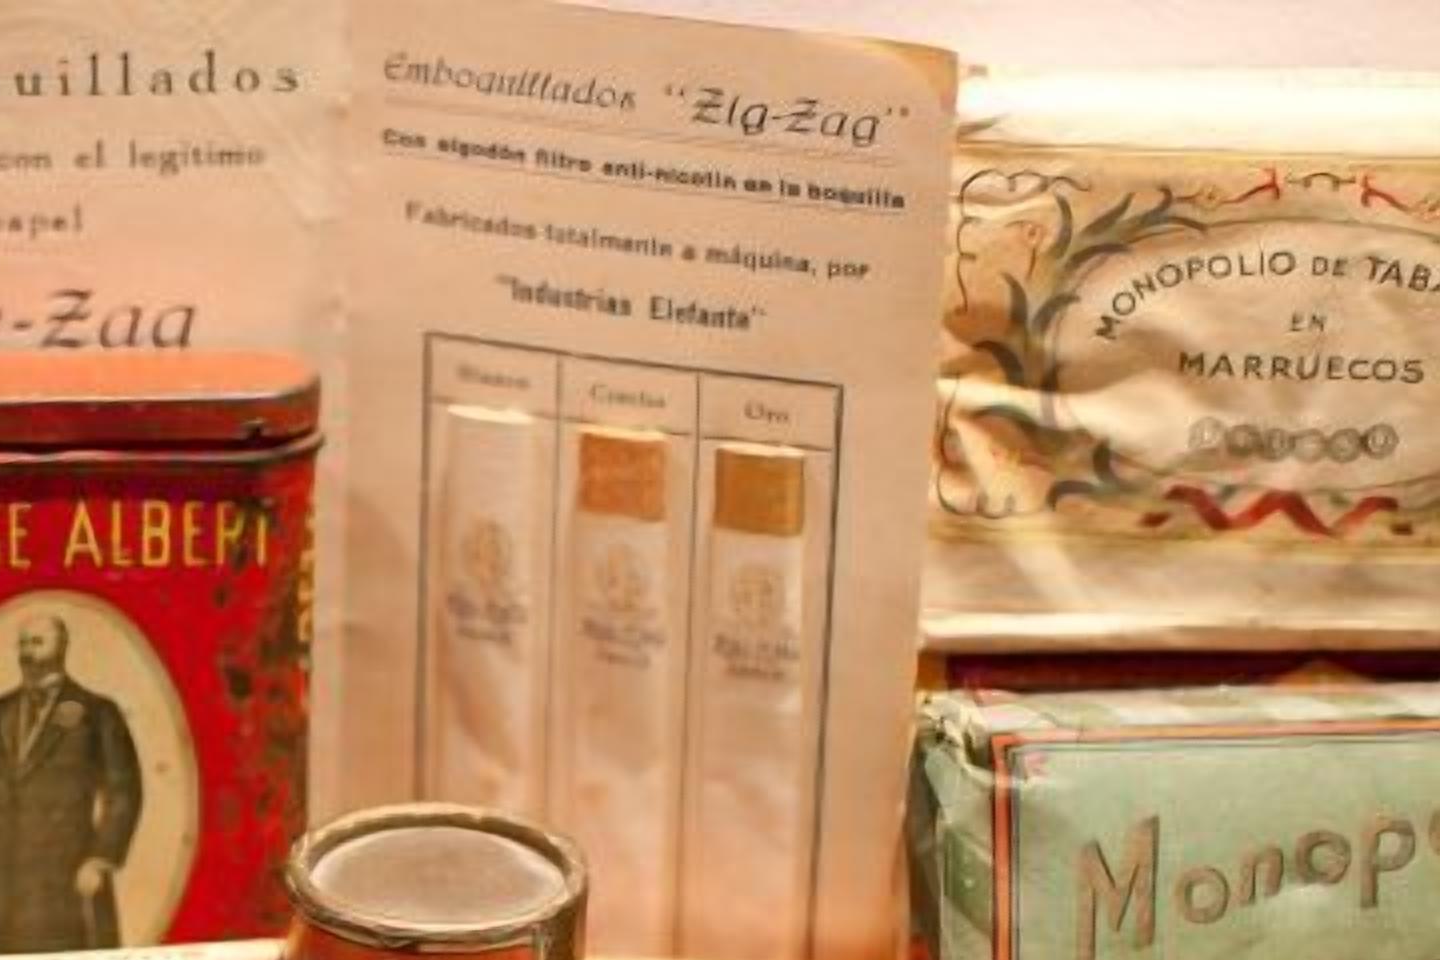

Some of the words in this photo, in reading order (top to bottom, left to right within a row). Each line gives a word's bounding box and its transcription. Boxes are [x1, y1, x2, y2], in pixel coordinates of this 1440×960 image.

[383, 52, 637, 110] Emboquillados
[73, 138, 104, 170] el
[382, 127, 427, 148] Con
[535, 147, 593, 174] filtro
[742, 177, 773, 193] en
[778, 172, 802, 197] la
[808, 180, 906, 208] boquilla
[405, 200, 536, 241] Fabricados
[544, 224, 673, 257] totalmente
[682, 246, 696, 261] a
[827, 257, 870, 280] por
[1095, 250, 1297, 341] MONOPOLIO
[1312, 255, 1348, 277] DE
[1290, 312, 1327, 333] EN
[1179, 351, 1425, 384] MARRUECOS
